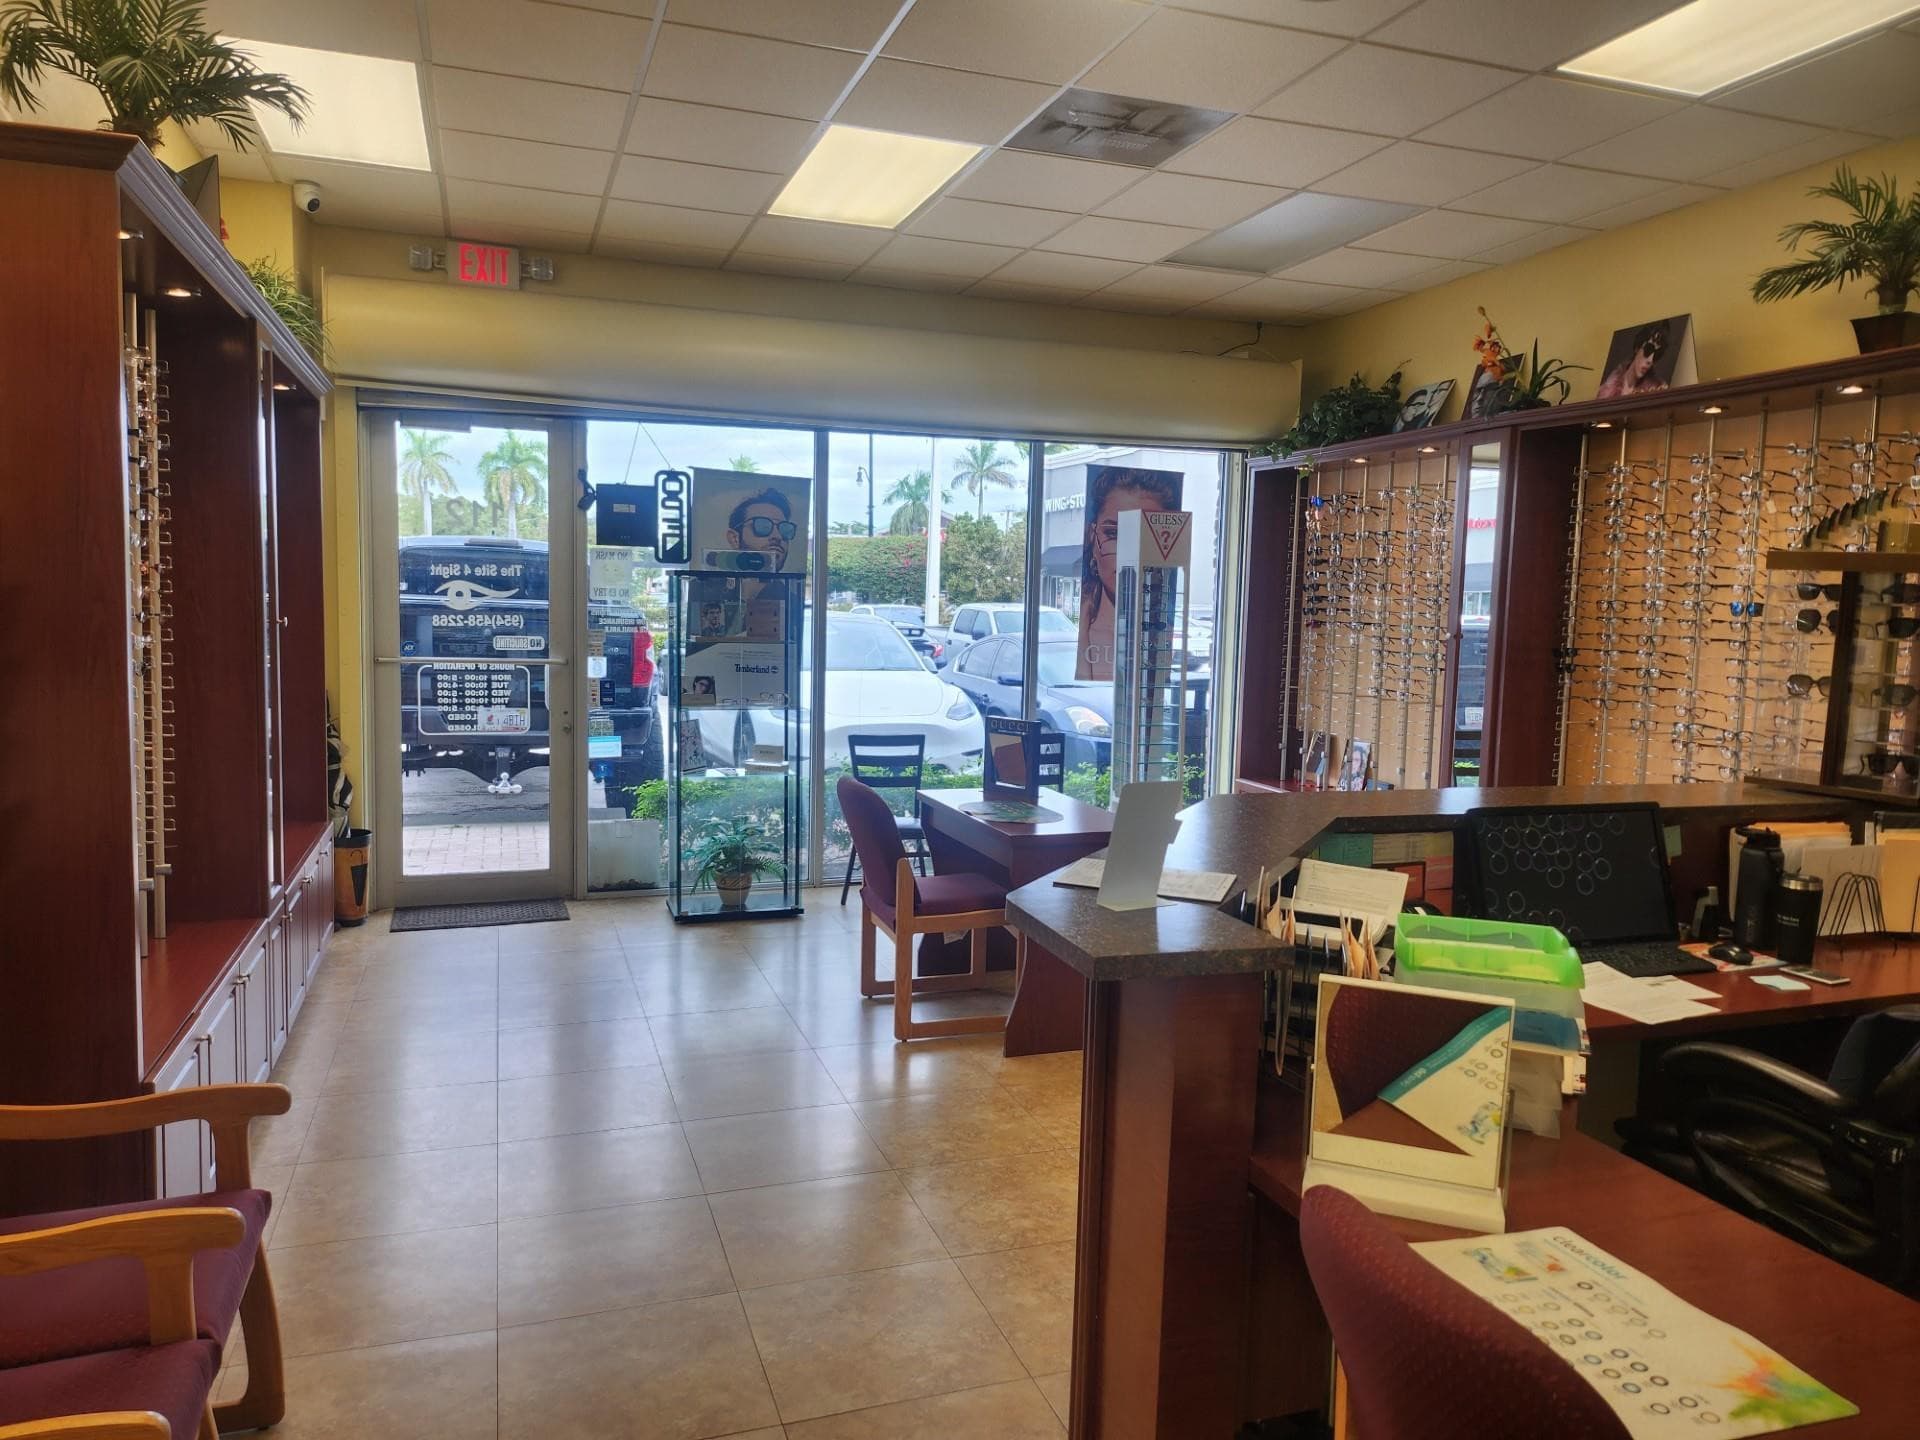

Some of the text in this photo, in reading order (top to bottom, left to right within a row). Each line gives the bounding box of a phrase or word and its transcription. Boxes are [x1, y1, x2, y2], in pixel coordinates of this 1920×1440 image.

[459, 243, 510, 286] EXIT
[1149, 513, 1184, 526] GUESS
[734, 663, 770, 674] Timberland
[990, 719, 1030, 732] GUCCI
